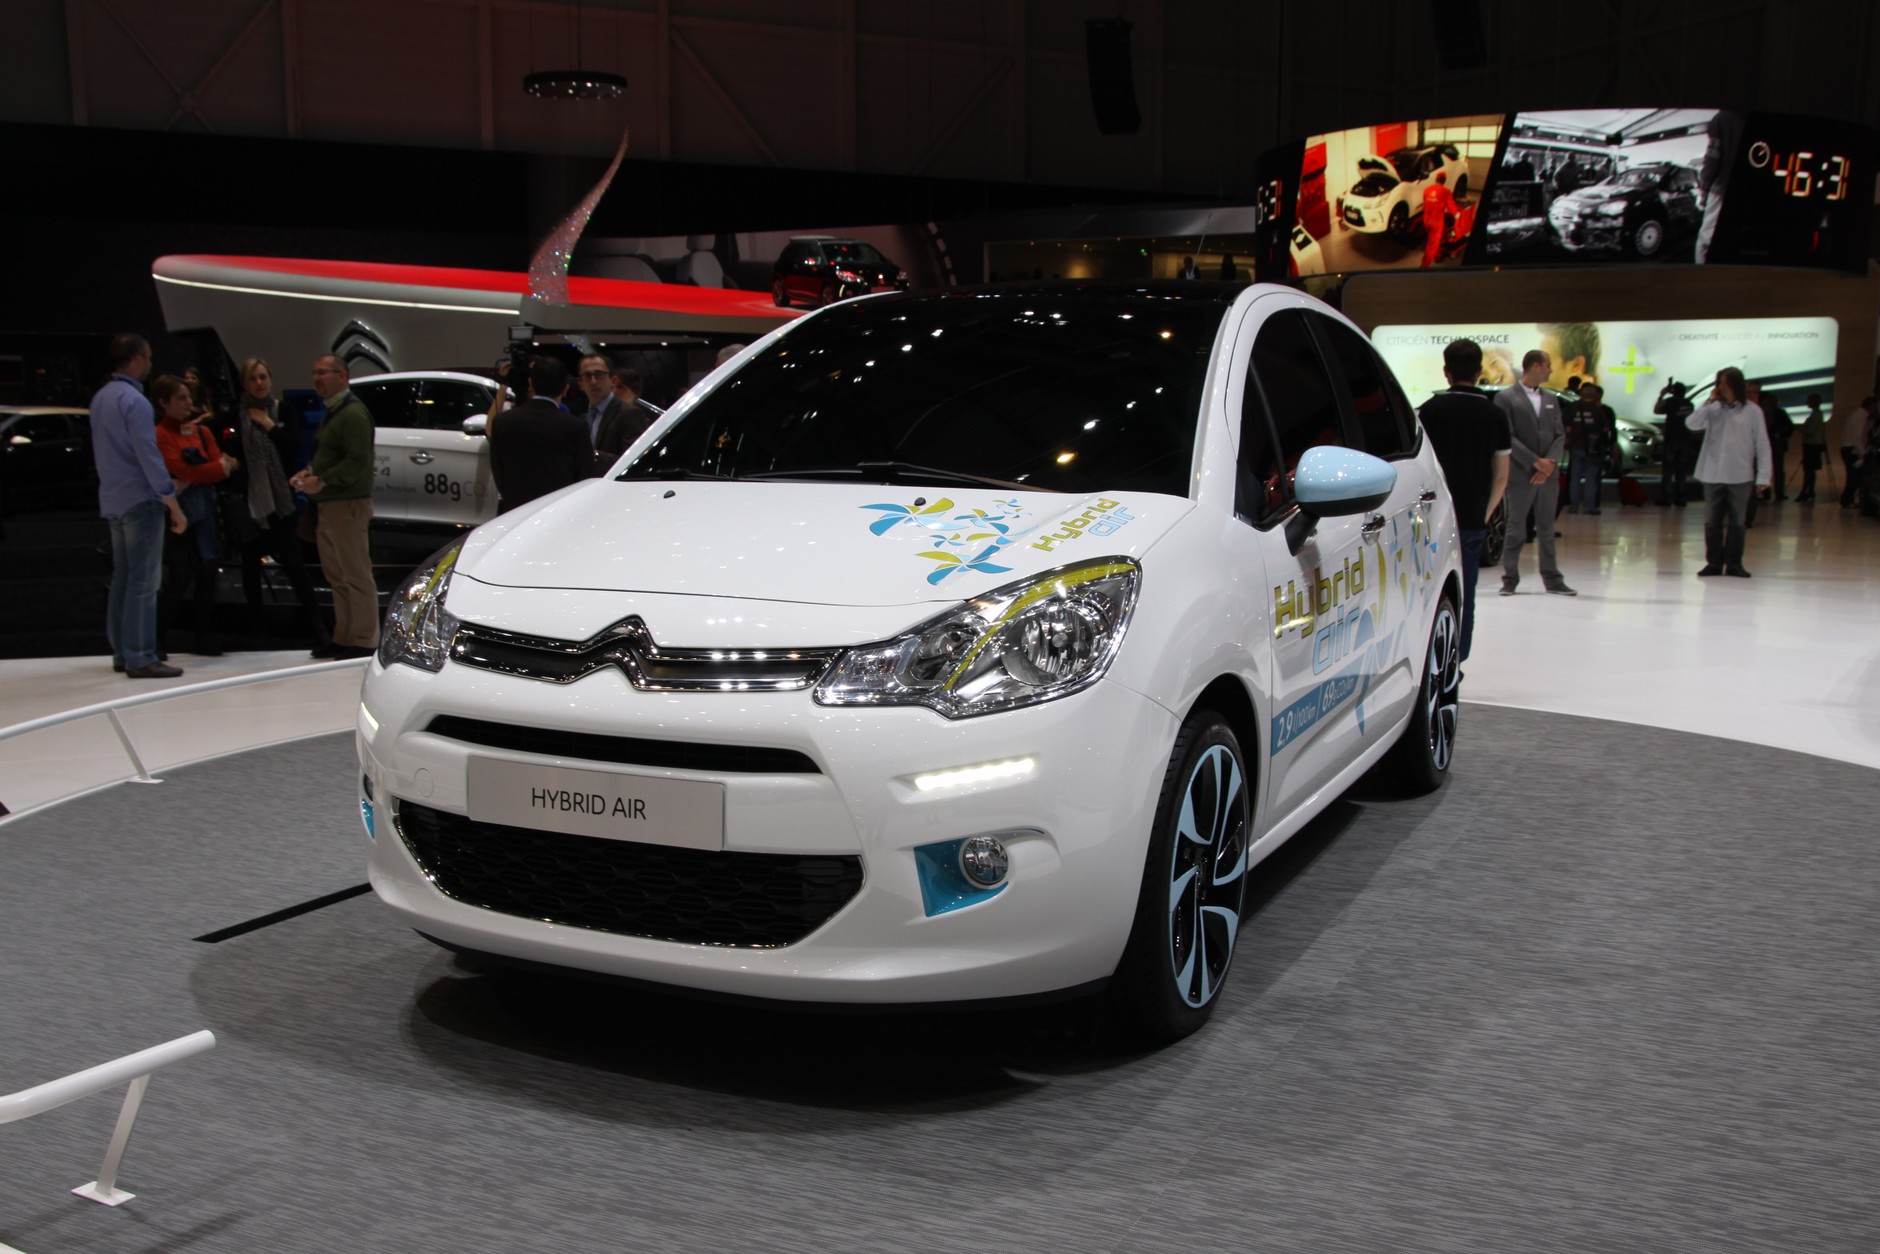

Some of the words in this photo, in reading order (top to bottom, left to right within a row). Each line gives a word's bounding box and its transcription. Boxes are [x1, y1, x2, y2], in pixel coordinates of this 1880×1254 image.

[1032, 498, 1120, 552] Hybrid
[1088, 506, 1135, 537] air
[1274, 546, 1364, 639] Hybrid
[1313, 605, 1359, 676] air
[531, 787, 606, 815] HYBRID
[611, 797, 647, 820] AIR
